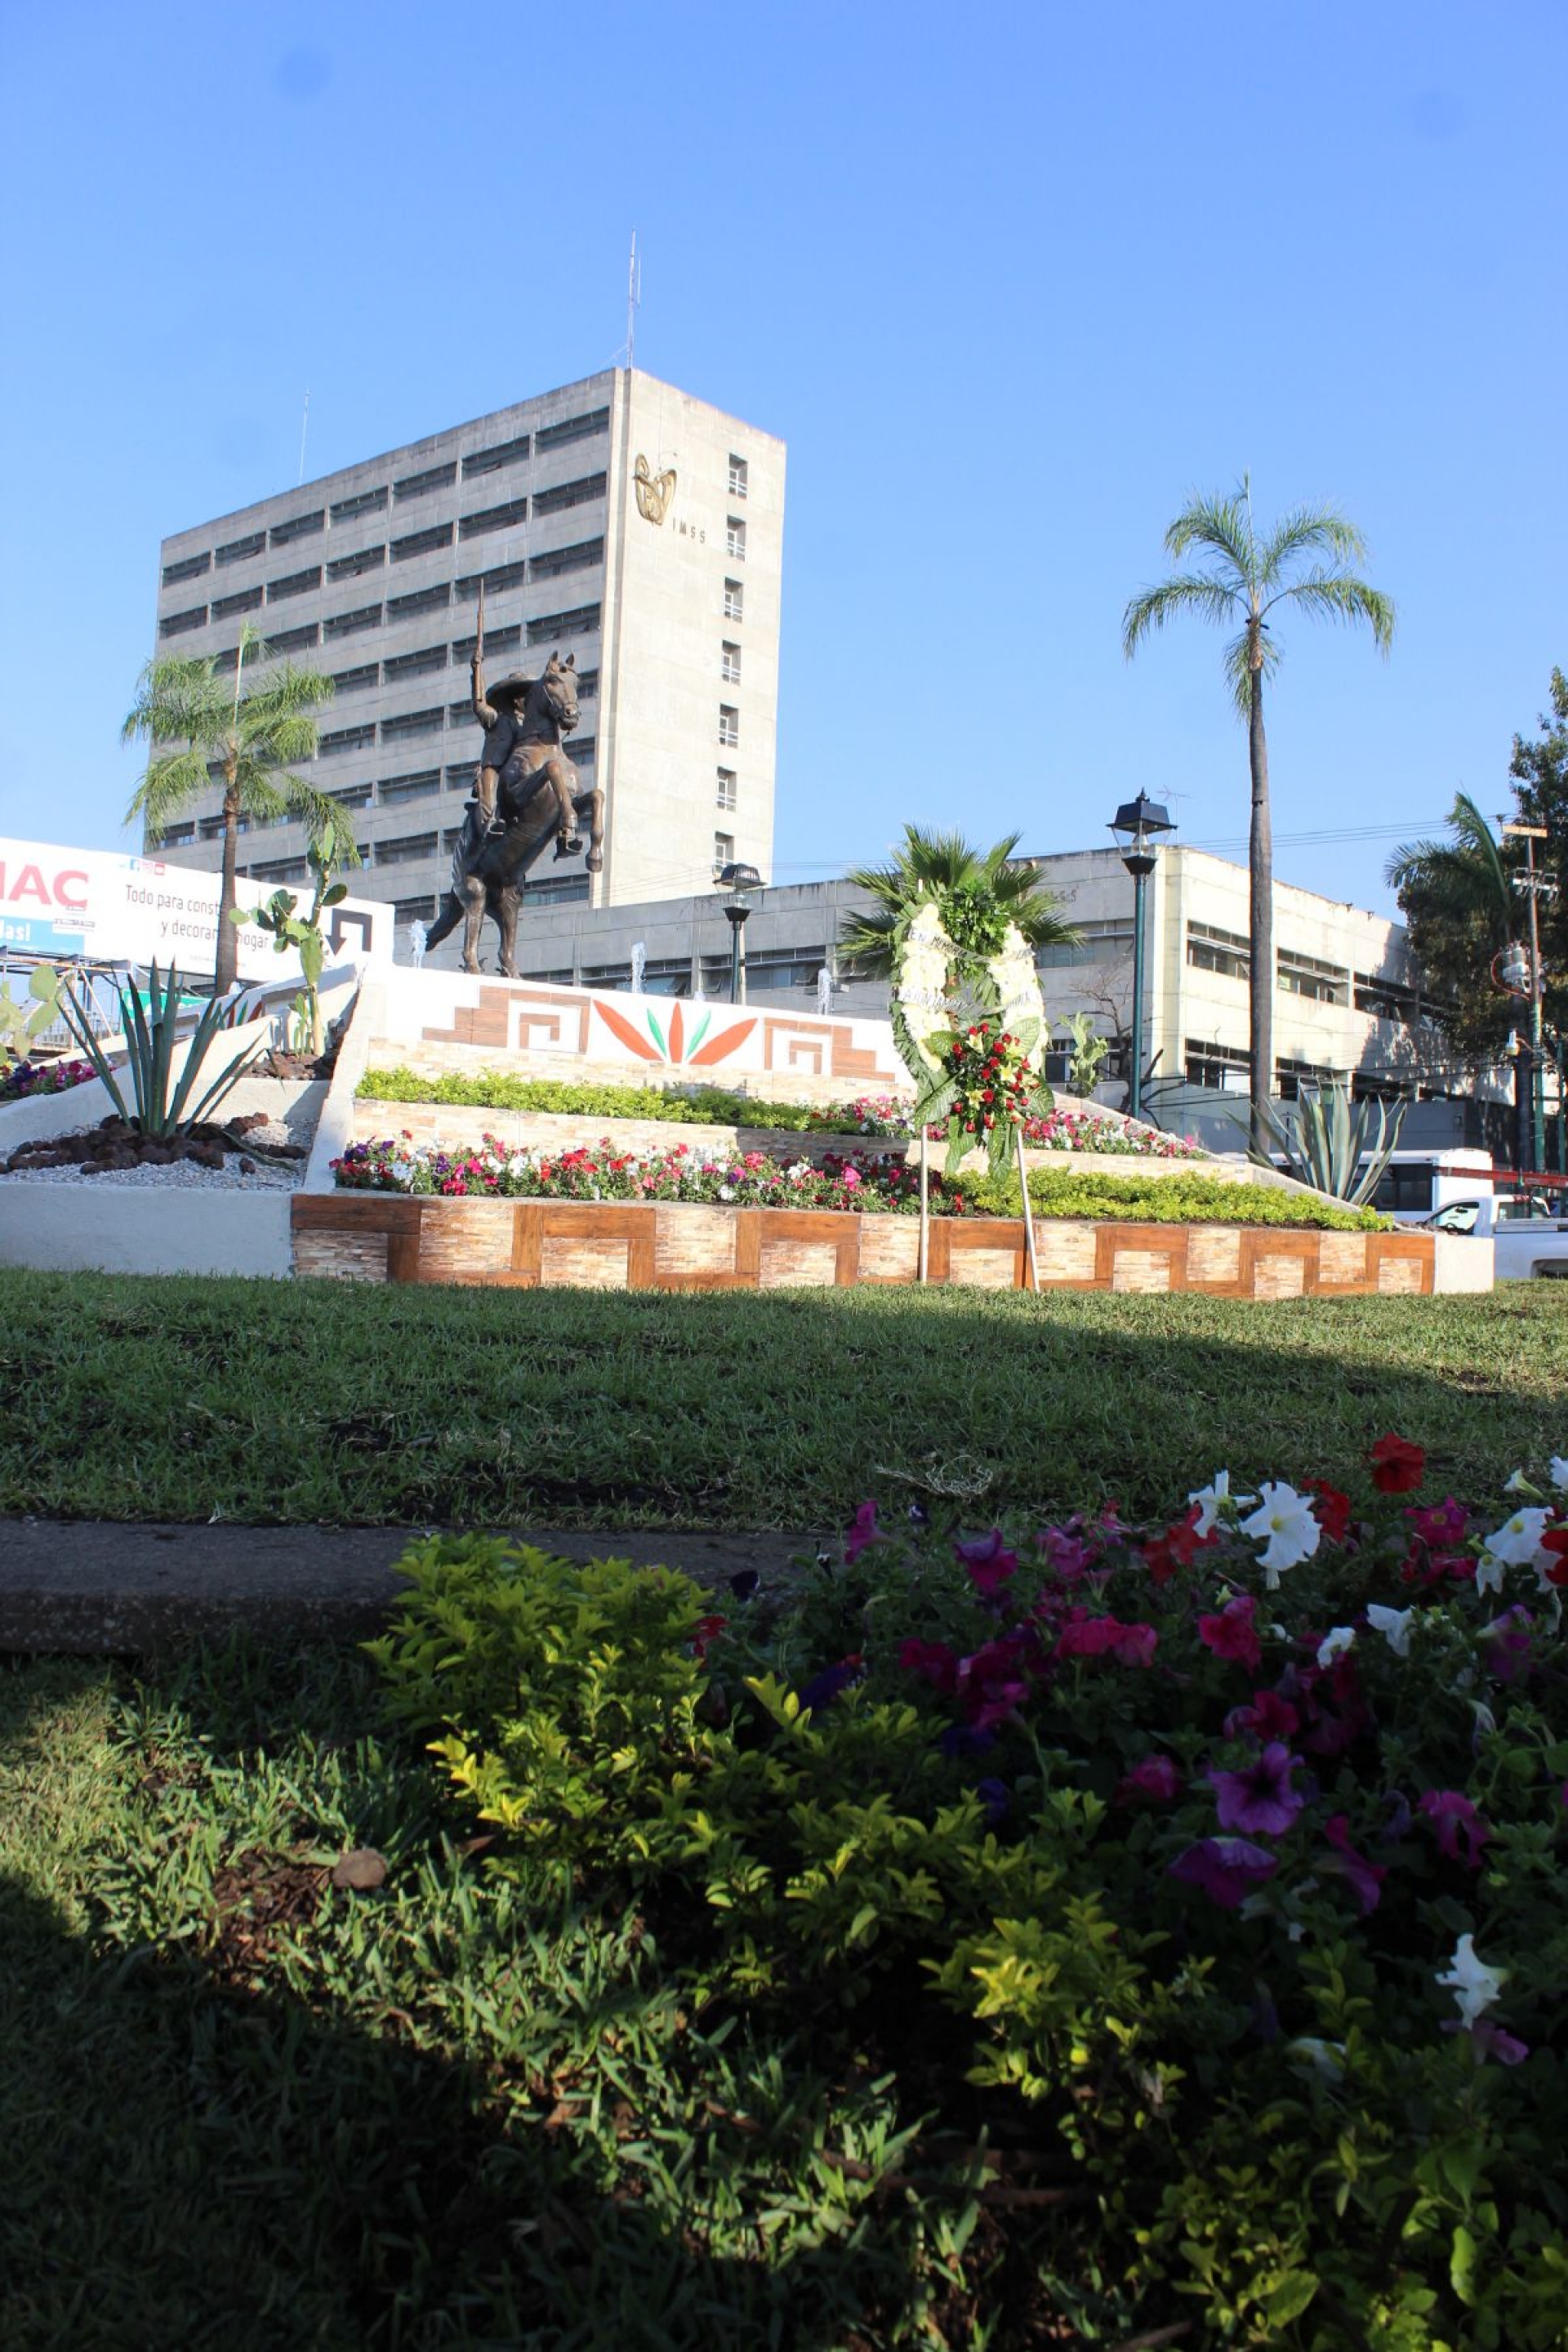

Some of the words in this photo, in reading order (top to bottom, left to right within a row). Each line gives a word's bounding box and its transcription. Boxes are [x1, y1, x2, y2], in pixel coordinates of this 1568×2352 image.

[672, 517, 706, 544] IMSS
[0, 860, 88, 909] AC
[125, 884, 154, 904] Todo
[158, 894, 184, 911] para
[160, 921, 168, 938] y
[172, 920, 218, 940] decorar
[237, 929, 269, 951] hogar
